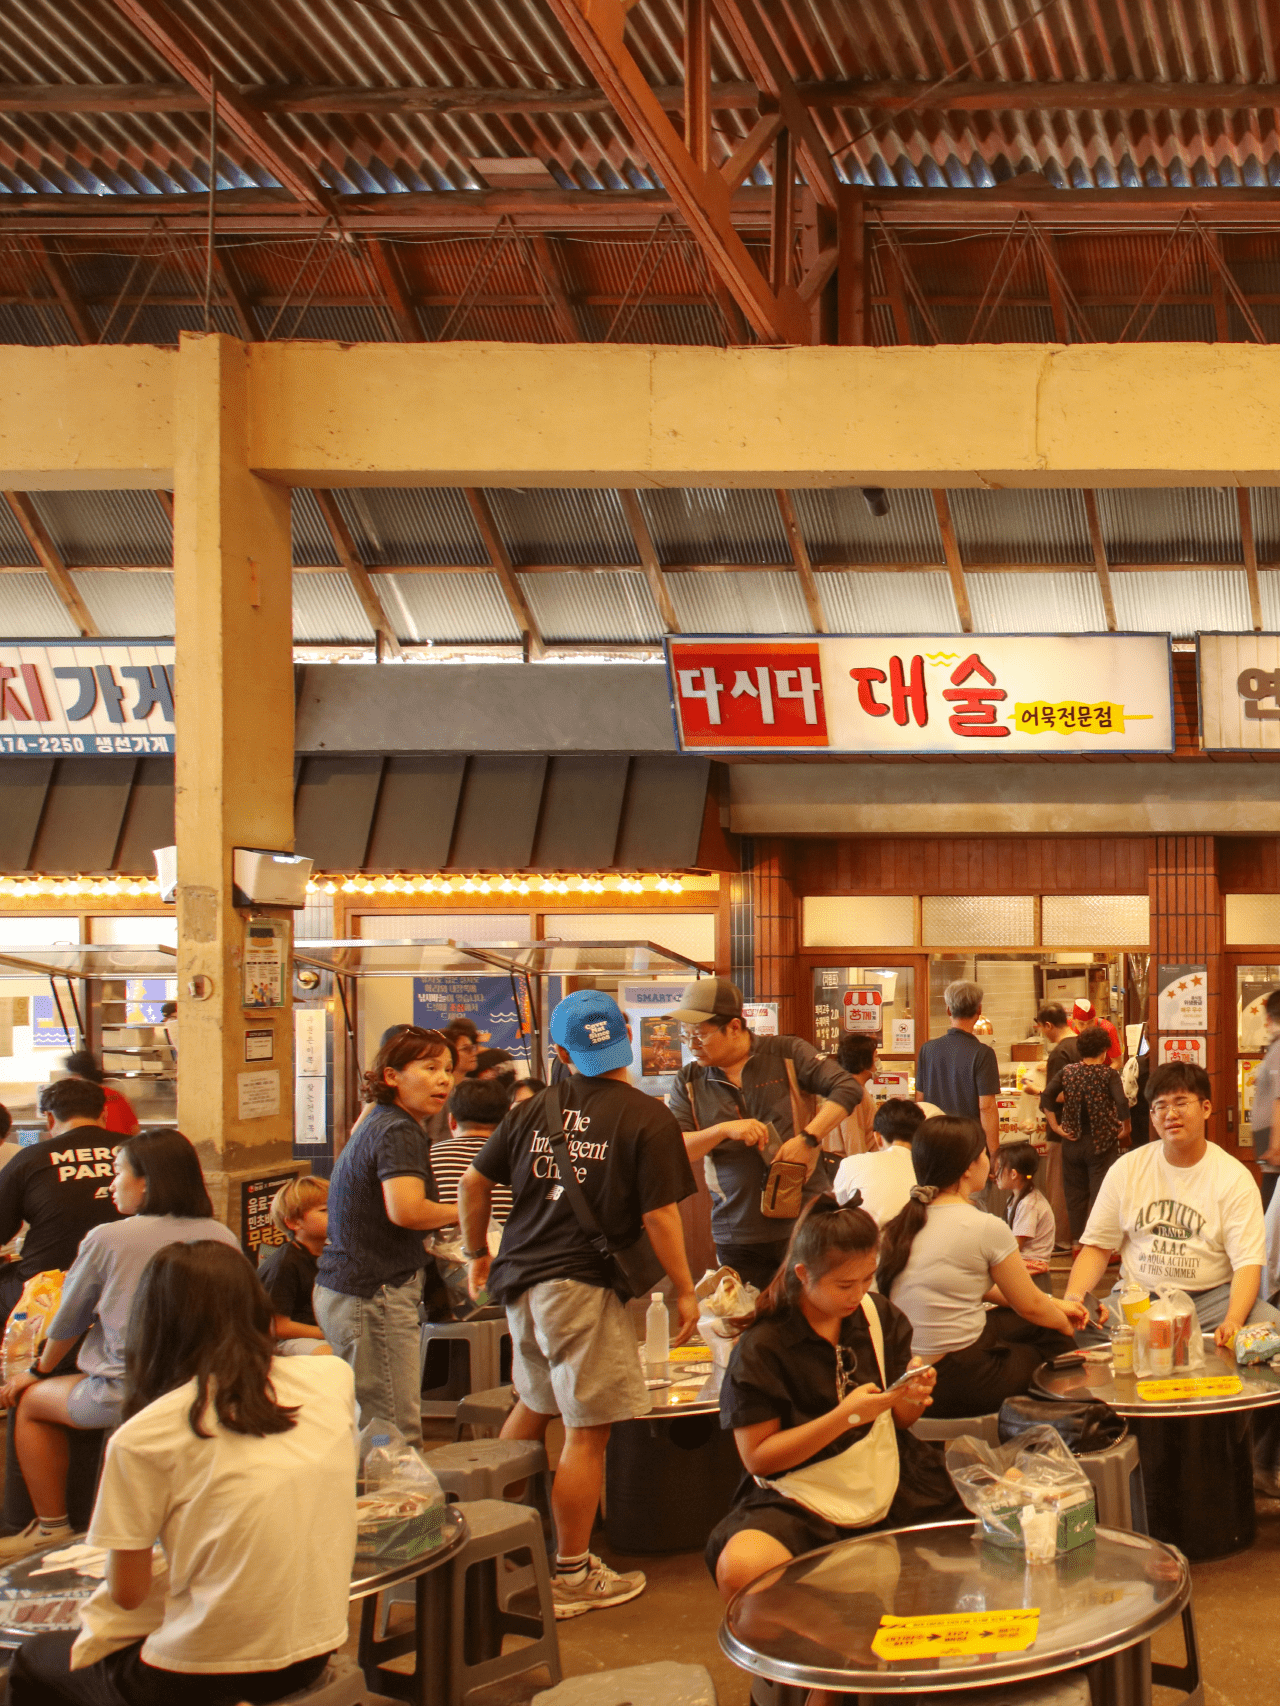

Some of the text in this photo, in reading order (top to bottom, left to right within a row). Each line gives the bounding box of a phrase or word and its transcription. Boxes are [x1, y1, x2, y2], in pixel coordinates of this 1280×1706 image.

[678, 667, 820, 725] 다시다
[850, 654, 1010, 737] 대술
[1020, 705, 1113, 728] 어묵전문점
[0, 737, 85, 753] 74-2250
[95, 736, 170, 753] 생선가게
[637, 994, 672, 1003] SMART
[562, 1109, 591, 1133] The
[530, 1130, 609, 1163] Intigent
[532, 1155, 588, 1184] Che
[1134, 1199, 1207, 1236] ACTIVITY
[1157, 1225, 1188, 1239] TRAVEL
[1151, 1239, 1187, 1256] S.A.A.C
[1147, 1254, 1165, 1265] AQUA
[1167, 1255, 1201, 1268] ACTIVITY
[1148, 1264, 1163, 1276] THIS
[1164, 1266, 1197, 1279] SUMMER
